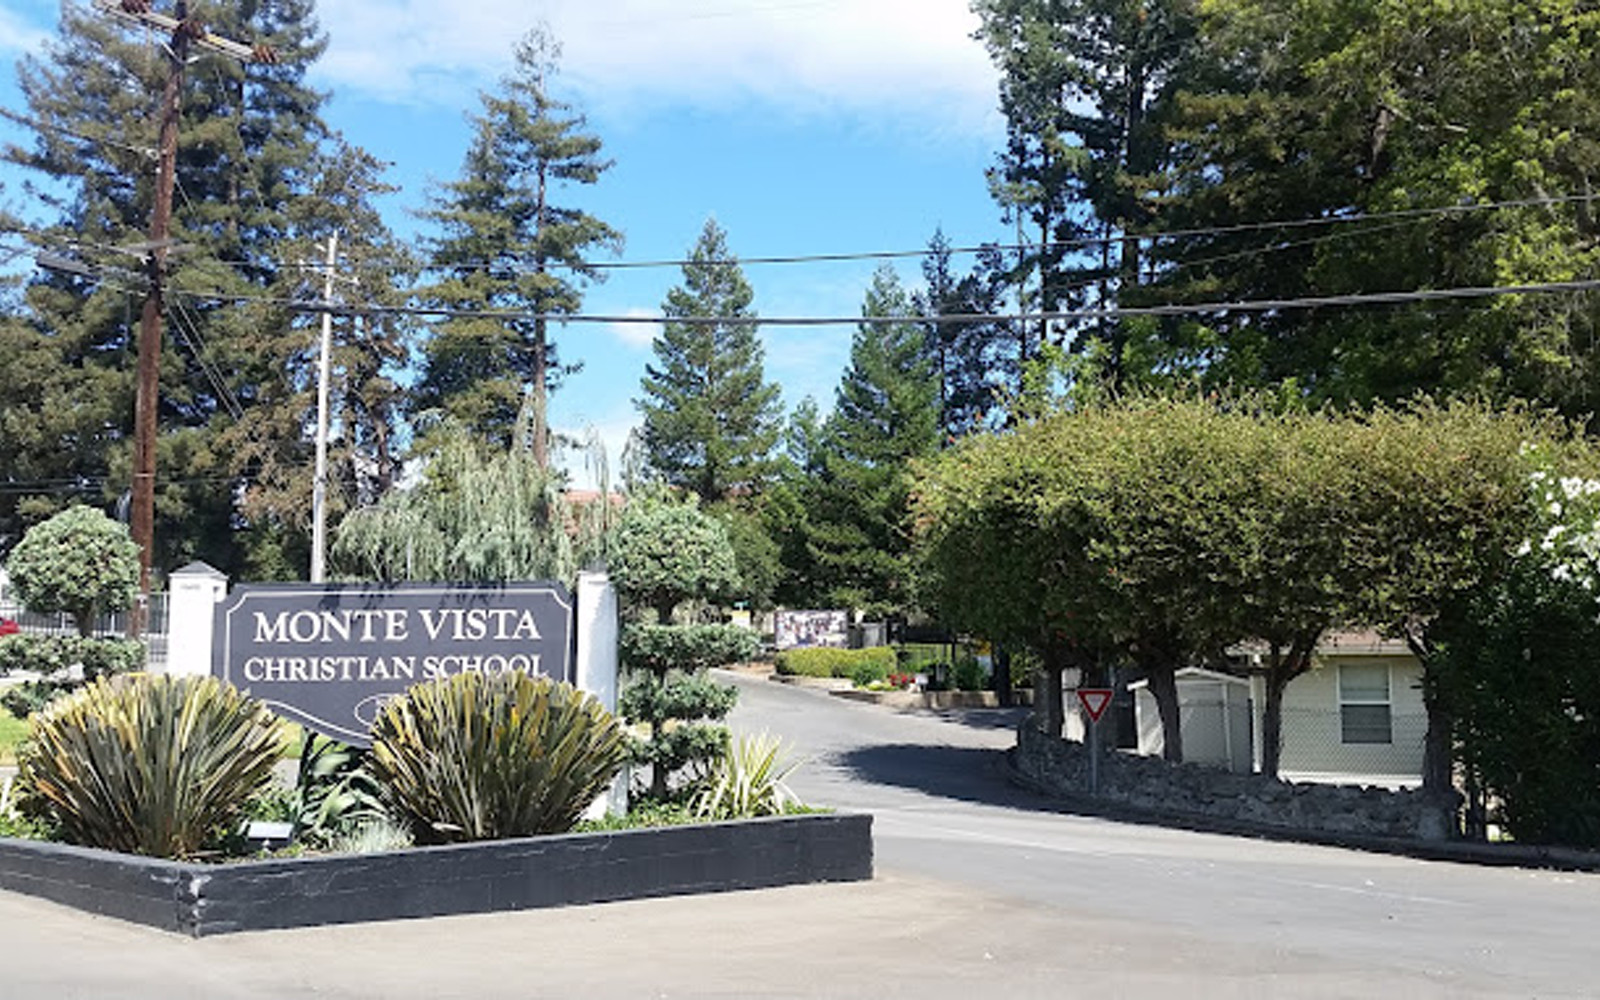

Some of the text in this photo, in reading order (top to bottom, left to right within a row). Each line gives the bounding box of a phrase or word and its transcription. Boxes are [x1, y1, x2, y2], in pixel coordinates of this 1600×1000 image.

[252, 608, 542, 643] MONTE VISTA
[244, 654, 550, 681] CHRISTIAN SCHOOL
